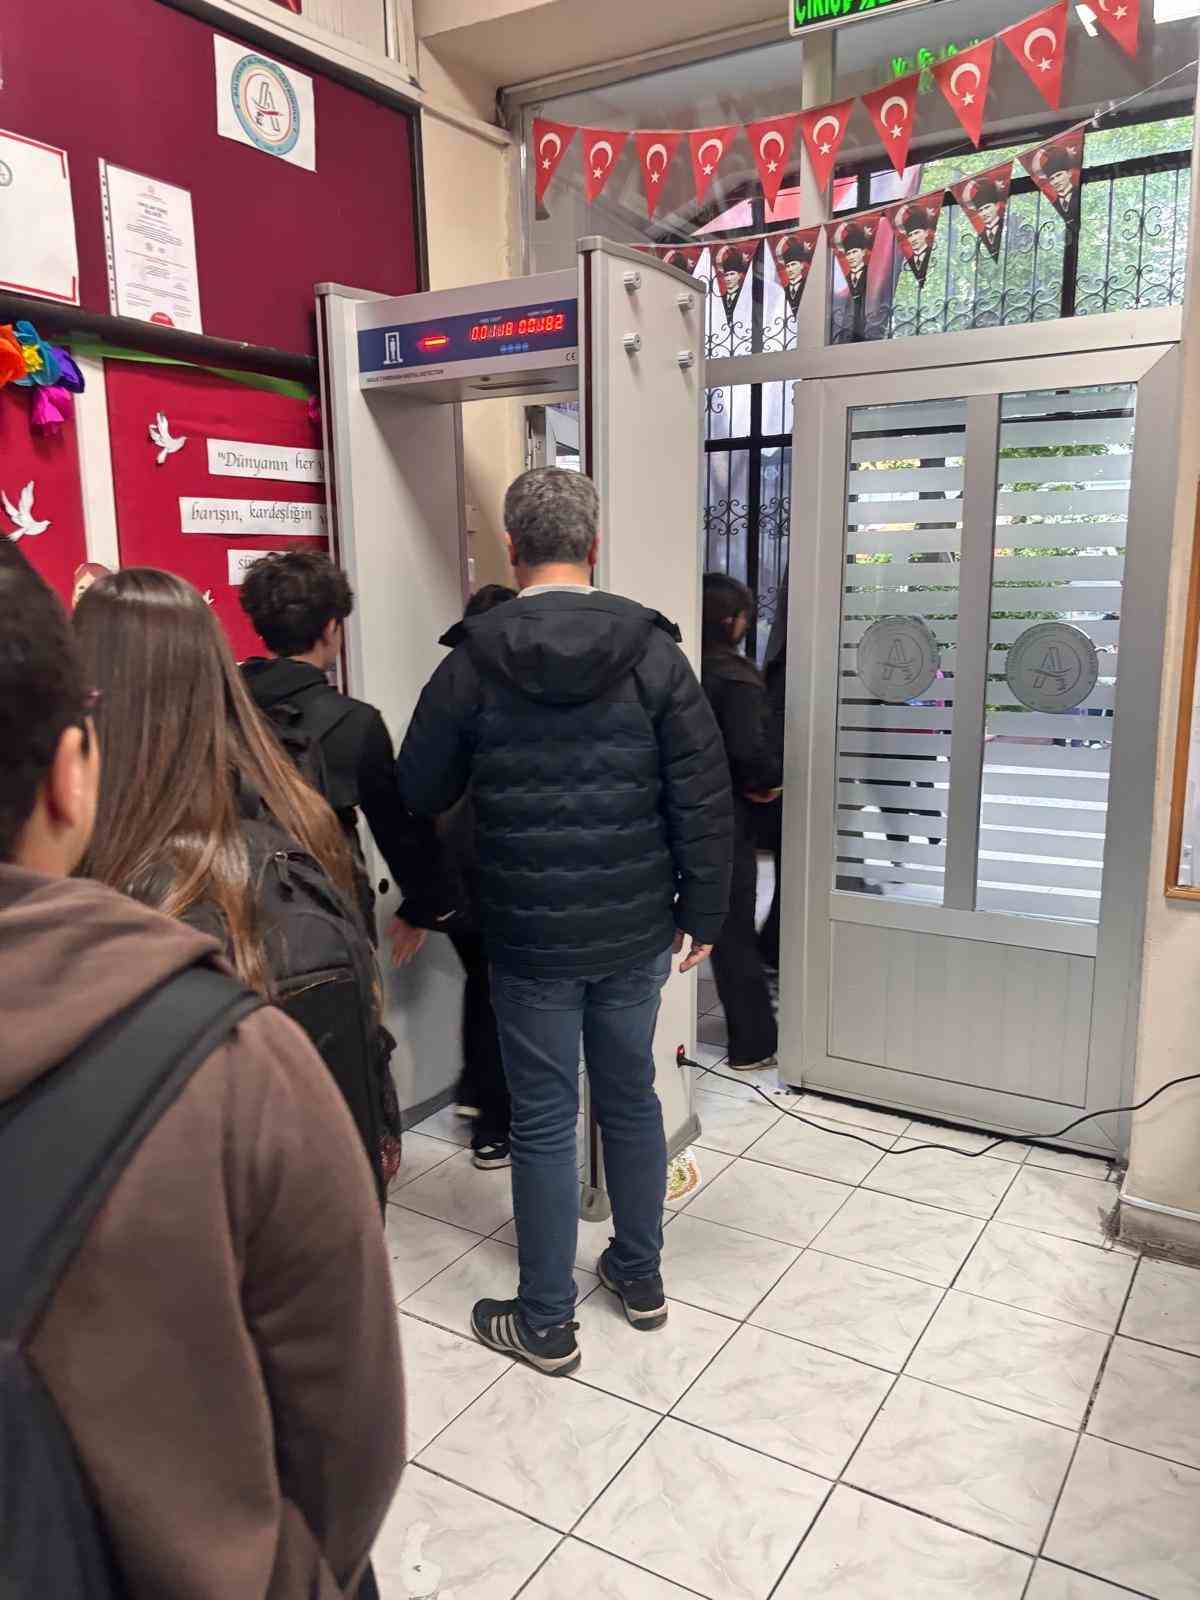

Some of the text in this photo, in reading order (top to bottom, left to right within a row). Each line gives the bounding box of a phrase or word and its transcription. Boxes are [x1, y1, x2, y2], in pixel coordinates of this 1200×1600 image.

[295, 452, 314, 472] her
[191, 502, 242, 524] barışın,
[250, 501, 312, 524] kardeşliğin
